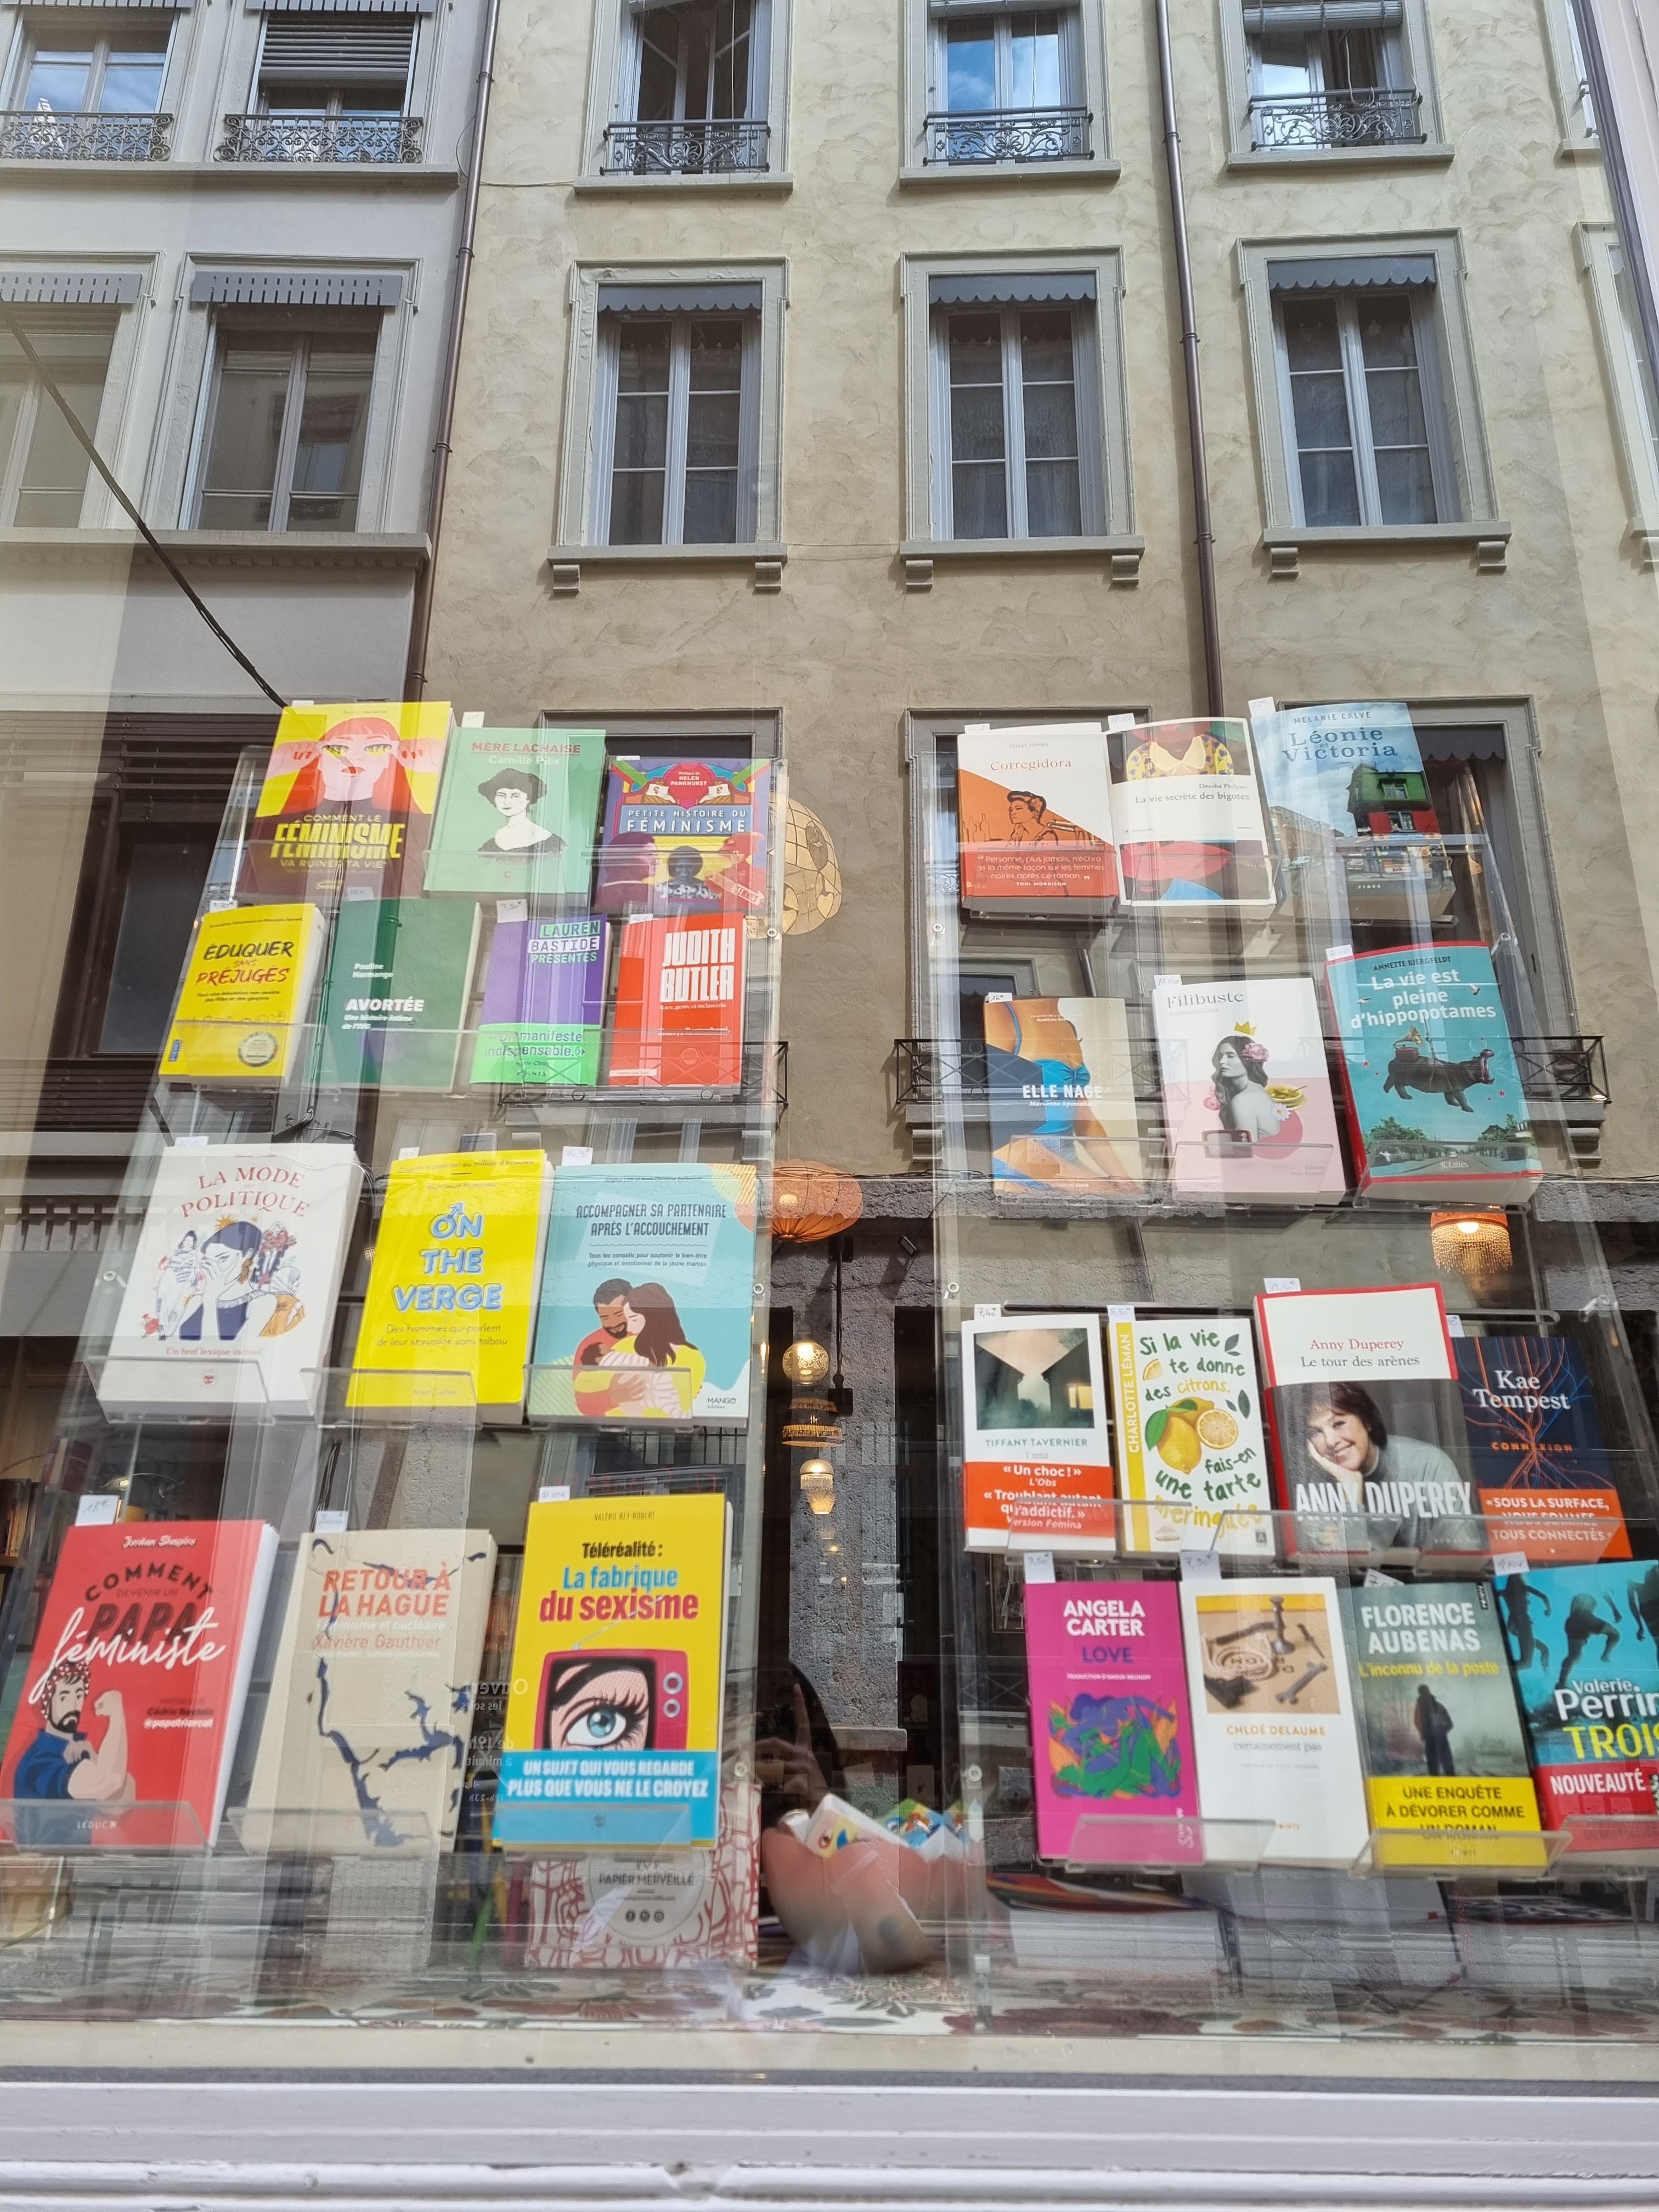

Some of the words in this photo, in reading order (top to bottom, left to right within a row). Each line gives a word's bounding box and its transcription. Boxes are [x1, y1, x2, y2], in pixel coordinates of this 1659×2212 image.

[472, 740, 510, 752] MÈRE
[514, 743, 581, 753] LACHAISE
[1289, 727, 1383, 747] Léonie
[488, 755, 532, 765] Camille
[1282, 742, 1398, 763] Victoria
[990, 759, 1071, 771] Corregidora
[1165, 793, 1197, 801] secrète
[1217, 792, 1250, 802] bigotes
[303, 814, 364, 822] COMMENT
[627, 817, 746, 832] FÉMINISME
[1017, 872, 1040, 881] après
[1023, 864, 1046, 872] façon
[542, 921, 600, 937] LAUREN
[203, 941, 295, 960] ÉDUQUER
[530, 938, 598, 953] BASTIDE
[662, 928, 736, 968] JUDITH
[353, 962, 385, 970] Pauline
[1373, 960, 1407, 972] ANNETTE
[1408, 956, 1452, 967] BJERGFELDT
[195, 964, 290, 987] PRÉJUGÉS
[661, 964, 734, 1003] BUTLER
[1371, 975, 1395, 990] La
[1398, 971, 1426, 986] vie
[1431, 969, 1461, 983] est
[345, 996, 425, 1012] AVORTÉE
[1167, 992, 1244, 1008] Filibuste
[1392, 989, 1448, 1009] pleine
[1351, 1005, 1497, 1030] d'hippopotames
[520, 1030, 583, 1042] manifeste
[1022, 1084, 1058, 1099] ELLE
[1063, 1085, 1103, 1099] NAGE
[198, 1170, 228, 1190] LA
[235, 1166, 306, 1188] MODE
[182, 1190, 311, 1218] POLITIQUE
[576, 1204, 647, 1218] ACCOMPAGNER
[651, 1204, 664, 1218] SA
[667, 1204, 727, 1218] PARTENAIRE
[430, 1205, 483, 1239] ON
[591, 1220, 622, 1236] APRÈS
[626, 1222, 710, 1236] L'ACCOUCHEMENT
[420, 1247, 484, 1274] THE
[392, 1283, 503, 1311] VERGE
[386, 1324, 404, 1334] Des
[407, 1324, 447, 1333] hommes
[467, 1324, 501, 1334] parlent
[1139, 1335, 1158, 1356] Si
[1163, 1332, 1182, 1352] la
[1190, 1328, 1221, 1348] vie
[1310, 1339, 1344, 1352] Anny
[1348, 1338, 1404, 1352] Duperey
[1119, 1333, 1134, 1378] LÉMAN
[1300, 1356, 1317, 1367] Le
[1321, 1357, 1347, 1367] tour
[1352, 1356, 1373, 1367] des
[1378, 1355, 1420, 1367] arènes
[1169, 1358, 1189, 1373] te
[1197, 1357, 1246, 1376] donne
[1494, 1369, 1541, 1390] Kae
[1145, 1386, 1171, 1402] des
[1177, 1378, 1231, 1393] citrons.
[1472, 1389, 1571, 1414] Tempest
[1122, 1380, 1140, 1454] CHARLOTTE
[985, 1438, 1028, 1447] TIFFANY
[1031, 1438, 1088, 1447] TAVERNIER
[1204, 1447, 1256, 1474] fais-en
[1013, 1464, 1031, 1476] Un
[1034, 1465, 1065, 1477] choc
[1029, 1477, 1057, 1487] L'Obs
[1155, 1469, 1193, 1500] une
[1203, 1472, 1261, 1502] tarte
[1295, 1481, 1359, 1514] ANNY
[1364, 1481, 1472, 1519] DUPEREY
[1530, 1498, 1547, 1508] LA
[1547, 1498, 1610, 1511] SURFACE,
[1046, 1519, 1082, 1530] Femina
[1492, 1529, 1525, 1540] TOUS
[84, 1561, 213, 1602] COMMENT
[323, 1568, 428, 1592] RETOUR
[433, 1562, 451, 1591] À
[563, 1566, 586, 1590] La
[591, 1564, 678, 1593] fabrique
[318, 1594, 351, 1617] LA
[357, 1594, 450, 1616] HAGUE
[539, 1589, 574, 1623] du
[579, 1587, 699, 1622] sexisme
[1063, 1599, 1146, 1618] ANGELA
[86, 1601, 199, 1649] PAPA
[1360, 1602, 1476, 1629] FLORENCE
[1066, 1618, 1146, 1637] CARTER
[314, 1633, 369, 1649] Xavière
[375, 1633, 441, 1649] Gauthier
[1368, 1628, 1481, 1655] AUBENAS
[29, 1606, 226, 1705] féministe
[1081, 1647, 1135, 1663] LOVE
[1359, 1663, 1423, 1678] L'inconnu
[1427, 1661, 1443, 1674] de
[1445, 1660, 1460, 1674] la
[1462, 1661, 1500, 1678] poste
[1571, 1678, 1633, 1695] Valérie
[1269, 1725, 1325, 1736] DELAUME
[523, 1759, 542, 1776] UN
[543, 1759, 579, 1776] SUJET
[579, 1759, 602, 1776] QUI
[604, 1759, 636, 1776] VOUS
[637, 1759, 695, 1777] REGARDE
[507, 1779, 543, 1797] PLUS
[544, 1779, 572, 1797] QUE
[574, 1779, 612, 1797] VOUS
[613, 1779, 634, 1797] NE
[635, 1779, 652, 1797] LE
[653, 1779, 709, 1798] CROYEZ
[1550, 1768, 1646, 1796] NOUVEAUTÉ
[1403, 1786, 1433, 1799] UNE
[1436, 1784, 1503, 1800] ENQUÊTE
[1385, 1802, 1396, 1818] À
[1399, 1802, 1468, 1818] DÉVORER
[1471, 1805, 1526, 1818] COMME
[599, 1872, 635, 1885] PAPIER
[637, 1872, 695, 1886] MERVEILLE
